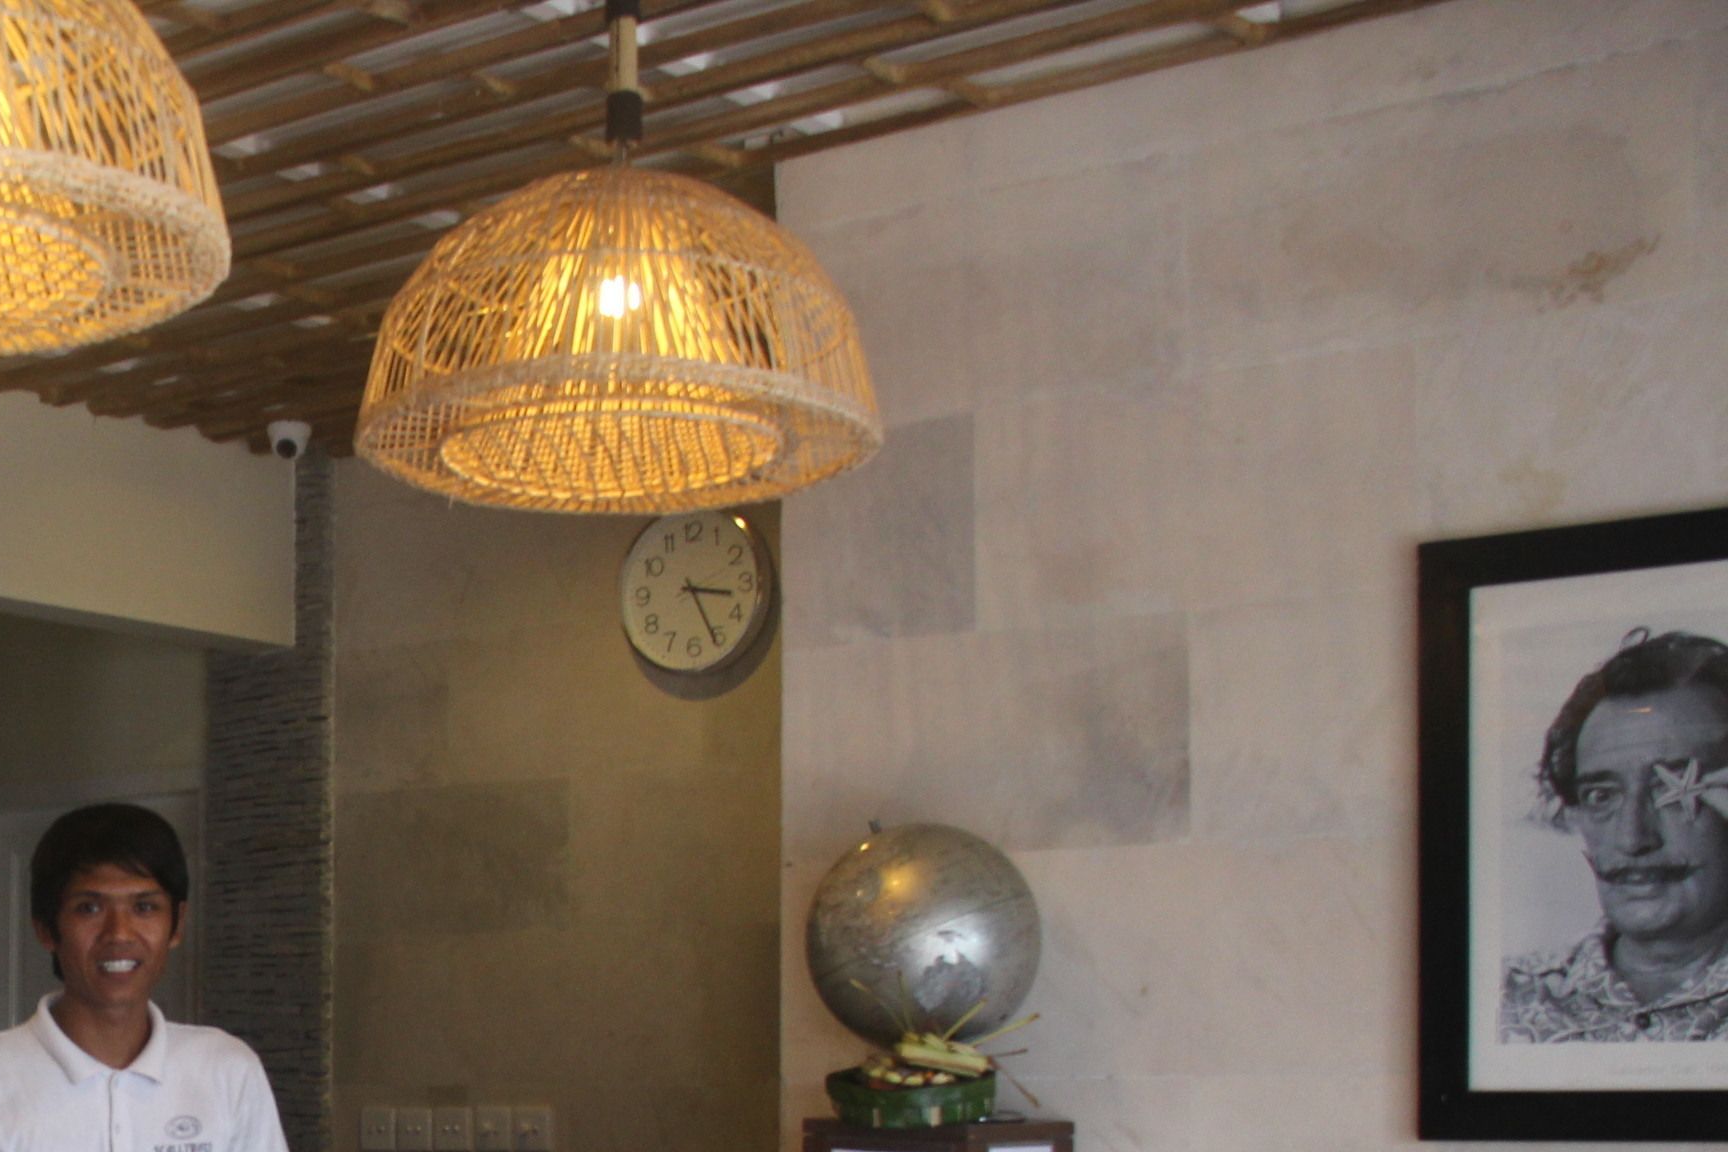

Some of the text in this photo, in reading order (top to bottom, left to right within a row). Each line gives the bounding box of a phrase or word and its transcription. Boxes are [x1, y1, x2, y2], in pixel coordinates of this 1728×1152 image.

[684, 521, 703, 542] 12
[713, 526, 720, 546] 1
[663, 533, 675, 553] 11
[728, 544, 743, 566] 2
[644, 556, 665, 577] 10
[738, 572, 753, 593] 3
[635, 586, 651, 607] 9
[728, 603, 744, 622] 4
[644, 614, 659, 634] 8
[663, 631, 677, 653] 7
[686, 636, 703, 657] 6
[711, 625, 727, 648] 5
